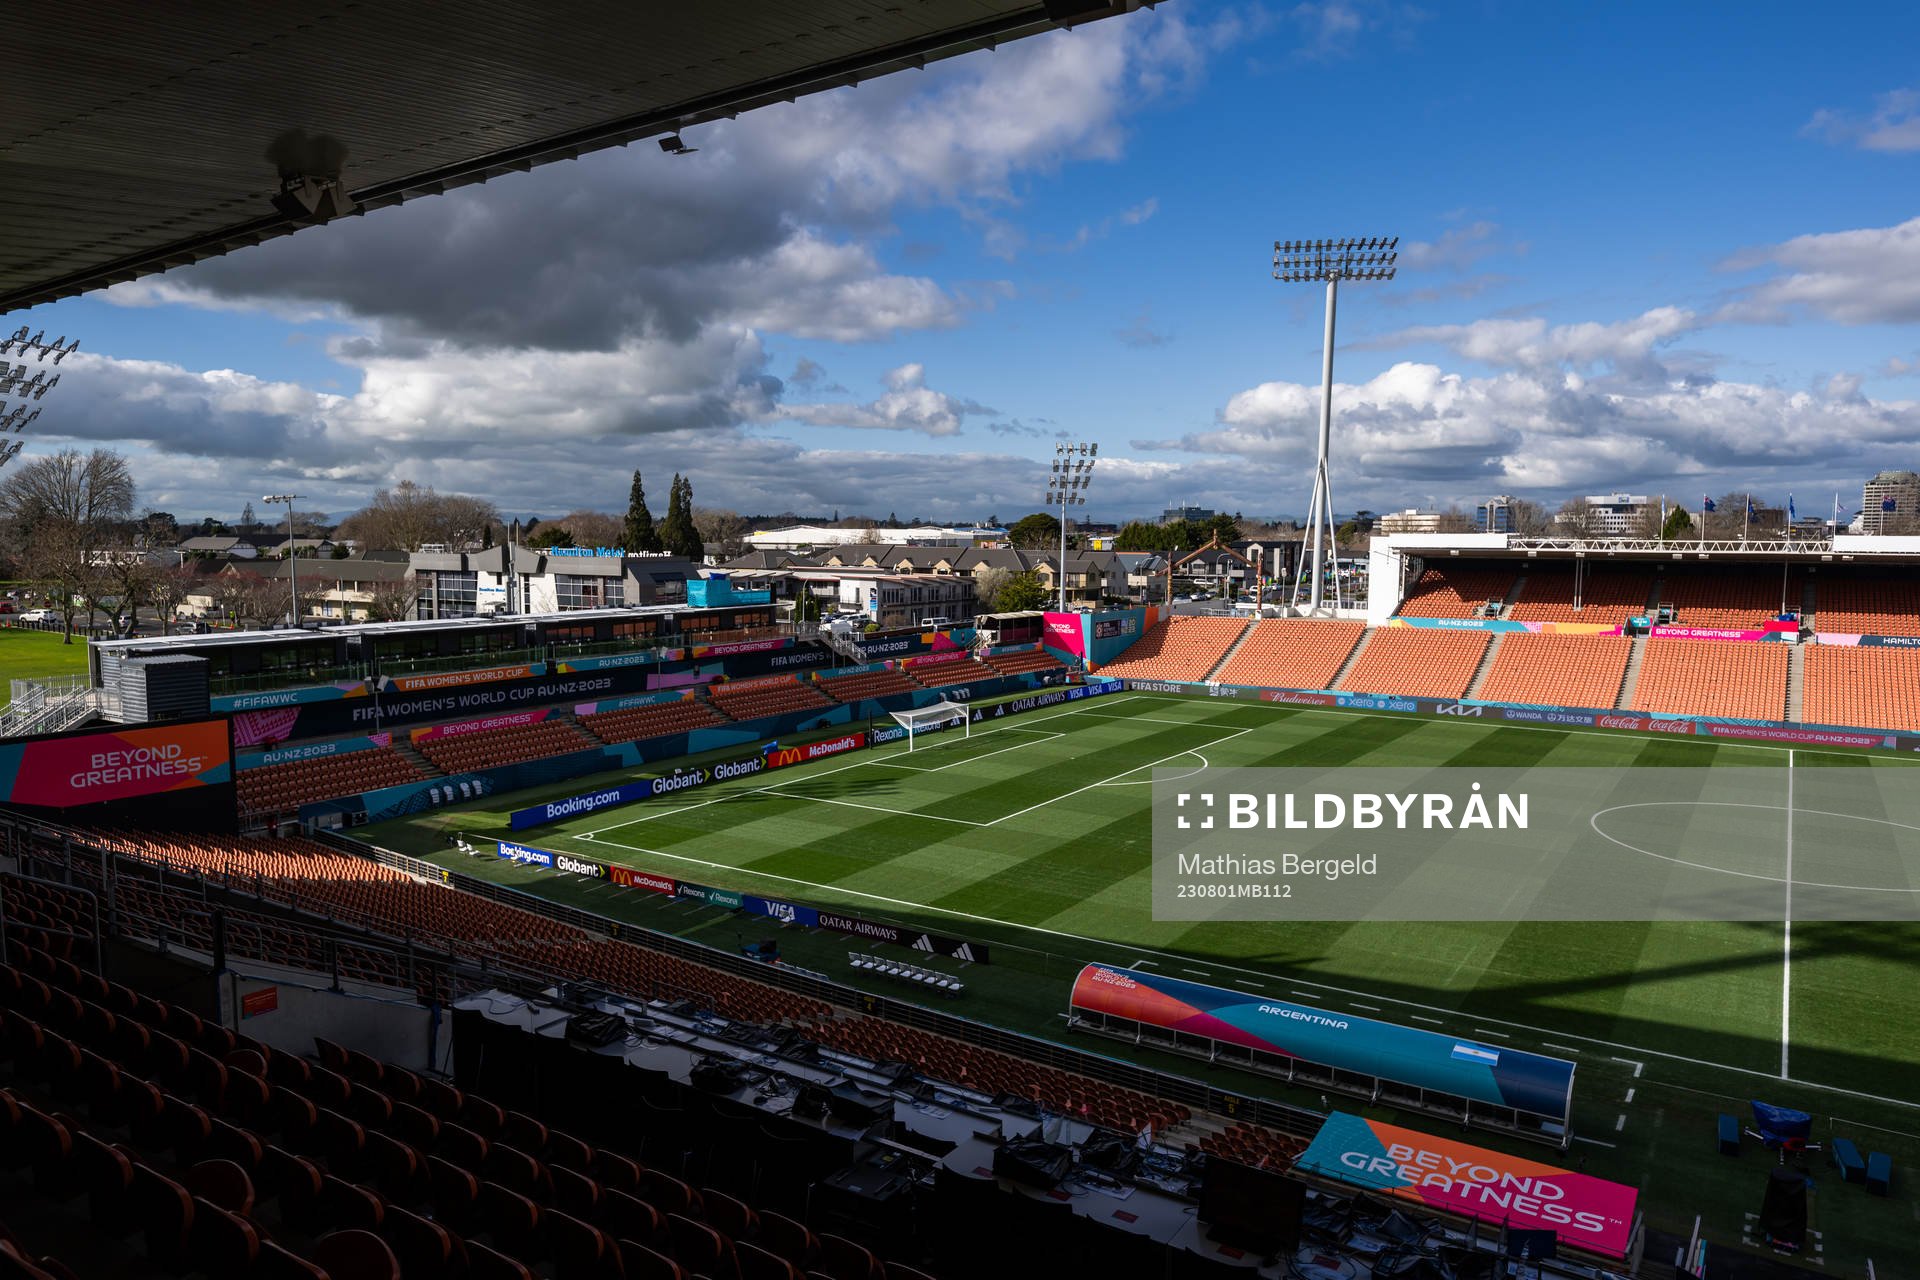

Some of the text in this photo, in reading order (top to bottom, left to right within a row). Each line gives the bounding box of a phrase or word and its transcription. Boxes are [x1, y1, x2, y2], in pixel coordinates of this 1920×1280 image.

[1655, 628, 1689, 636] BEYOND
[714, 645, 739, 655] BEYOND
[771, 656, 788, 667] FIFA
[788, 651, 825, 664] WOMEN'S
[405, 668, 524, 689] FIFA WOMEN'S WORLD CUP
[1107, 681, 1122, 692] VISA
[1069, 688, 1083, 699] VISA
[1088, 685, 1103, 696] VISA
[1131, 681, 1182, 693] FIFA STORE
[233, 692, 298, 709] #FIFAWWC
[353, 706, 385, 721] FIFA
[387, 697, 456, 717] WOMEN'S
[458, 691, 506, 708] WORLD
[509, 687, 535, 700] CUP
[1012, 690, 1066, 713] QATAR AIRWAYS
[1270, 691, 1326, 706] Budweiser
[1349, 697, 1374, 708] xero
[1389, 700, 1415, 711] xero
[1516, 711, 1543, 720] WANDA
[443, 722, 480, 735] BEYOND
[874, 728, 903, 743] Rexona
[1730, 729, 1767, 738] WOMEN'S
[1768, 731, 1797, 740] WORLD
[1798, 733, 1814, 741] CUP
[809, 737, 855, 757] McDonald's
[91, 744, 182, 769] BEYOND
[714, 757, 760, 781] Globant
[652, 769, 704, 794] Globant
[547, 790, 620, 819] Booking.com
[557, 855, 599, 878] Globant
[634, 875, 673, 891] McDonald's
[683, 885, 705, 898] Rexona
[714, 892, 738, 906] Rexona
[764, 901, 796, 921] VISA
[819, 914, 897, 941] QATAR AIRWAYS
[1258, 1005, 1349, 1030] ARGENTINA
[1385, 1143, 1565, 1200] BEYOND
